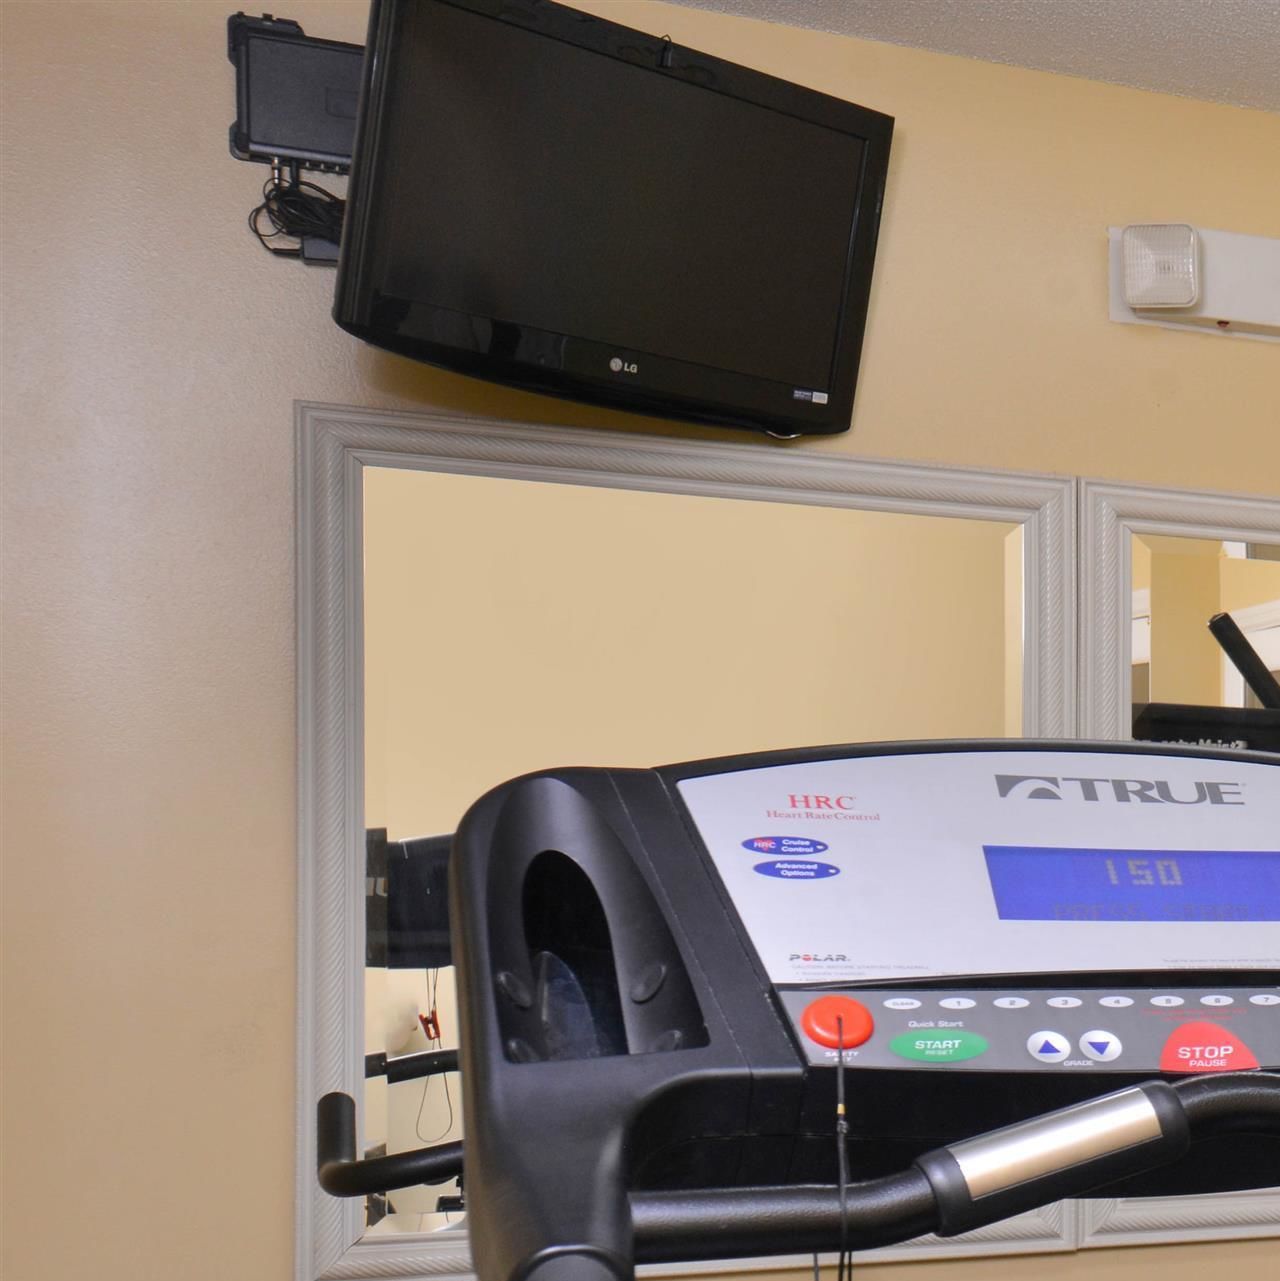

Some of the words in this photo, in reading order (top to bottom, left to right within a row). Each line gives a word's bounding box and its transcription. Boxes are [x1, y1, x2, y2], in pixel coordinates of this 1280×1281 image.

[624, 362, 638, 373] LG
[1061, 777, 1245, 805] TRUE
[788, 794, 855, 810] HRC
[766, 810, 801, 820] Heart
[805, 811, 832, 820] Rate
[833, 812, 881, 821] Control
[753, 841, 776, 849] HRC
[775, 862, 818, 870] Advanced
[1105, 858, 1184, 886] 150
[789, 954, 847, 962] POLAR
[908, 1020, 935, 1028] Quick
[938, 1020, 964, 1028] Start
[914, 1039, 962, 1049] START
[1178, 1045, 1233, 1059] STOP
[1189, 1059, 1227, 1067] PAUSE
